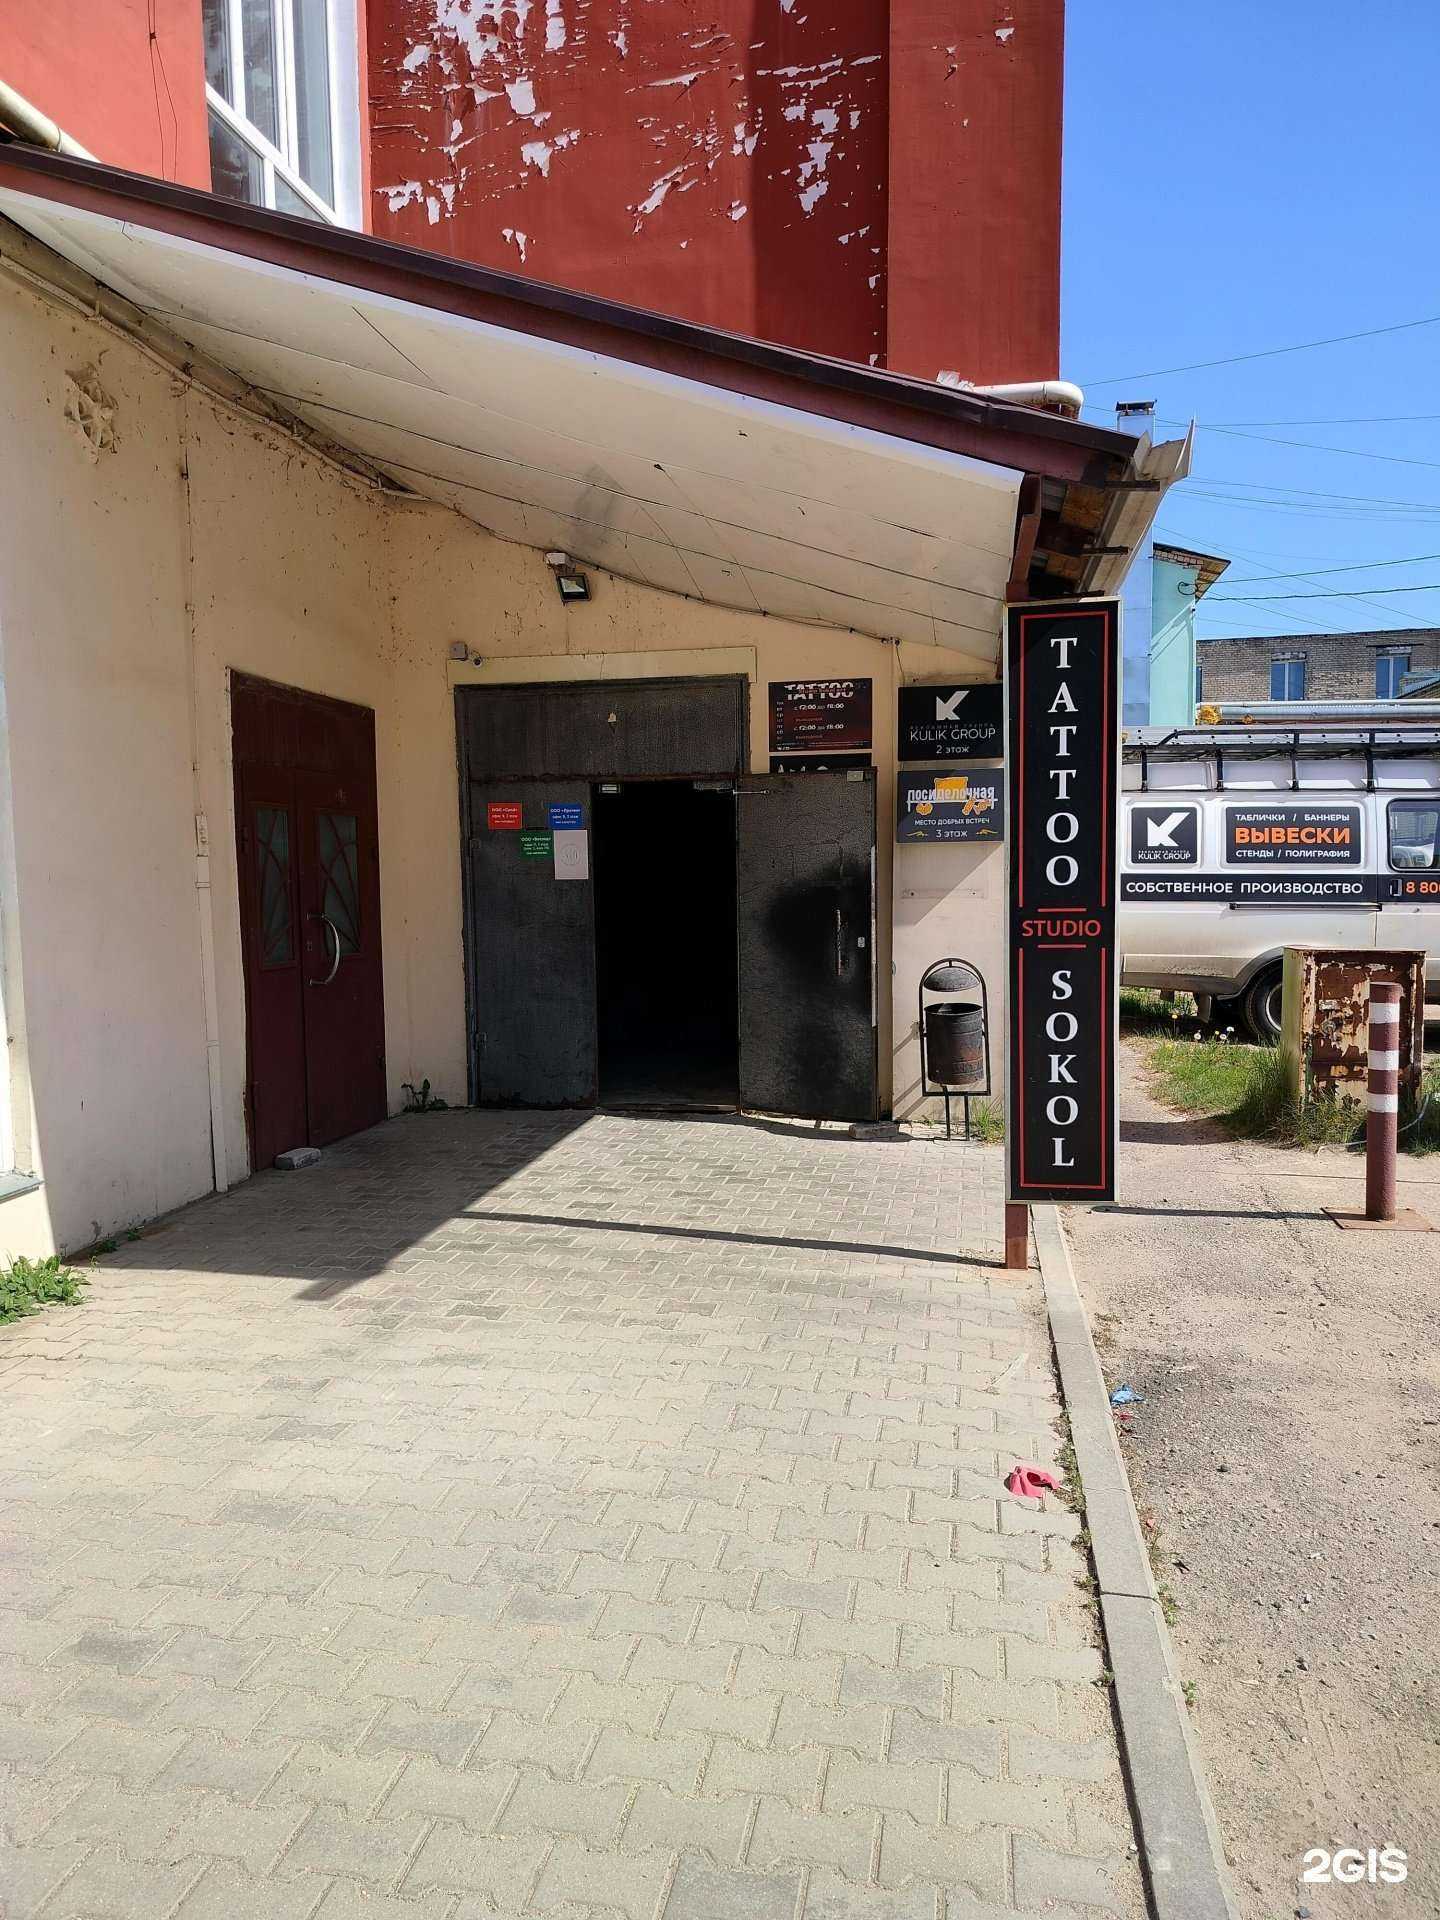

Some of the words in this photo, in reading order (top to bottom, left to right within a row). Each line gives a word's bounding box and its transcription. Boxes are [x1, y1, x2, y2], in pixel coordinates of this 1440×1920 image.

[910, 729, 947, 741] KULIK
[950, 728, 996, 740] GROUP
[936, 744, 942, 754] 2
[945, 746, 970, 754] этаж
[1045, 637, 1080, 886] TATTOO
[1235, 813, 1286, 822] ТАБЛИЧКИ
[1304, 813, 1350, 822] БАННЕРЫ
[936, 829, 942, 838] 3
[944, 830, 968, 838] этаж
[1235, 827, 1350, 845] ВЫВЕСКИ
[1235, 849, 1274, 858] СТЕНДЫ
[1285, 849, 1350, 858] ПОЛИГРАФИЯ
[1126, 881, 1233, 894] СОБСТВЕННОЕ
[1240, 881, 1363, 896] ПРОИЗВОДСТВО
[1406, 881, 1416, 894] 8
[1420, 881, 1440, 894] 80
[1021, 918, 1102, 938] STUDIO
[1045, 969, 1080, 1168] SOKOL
